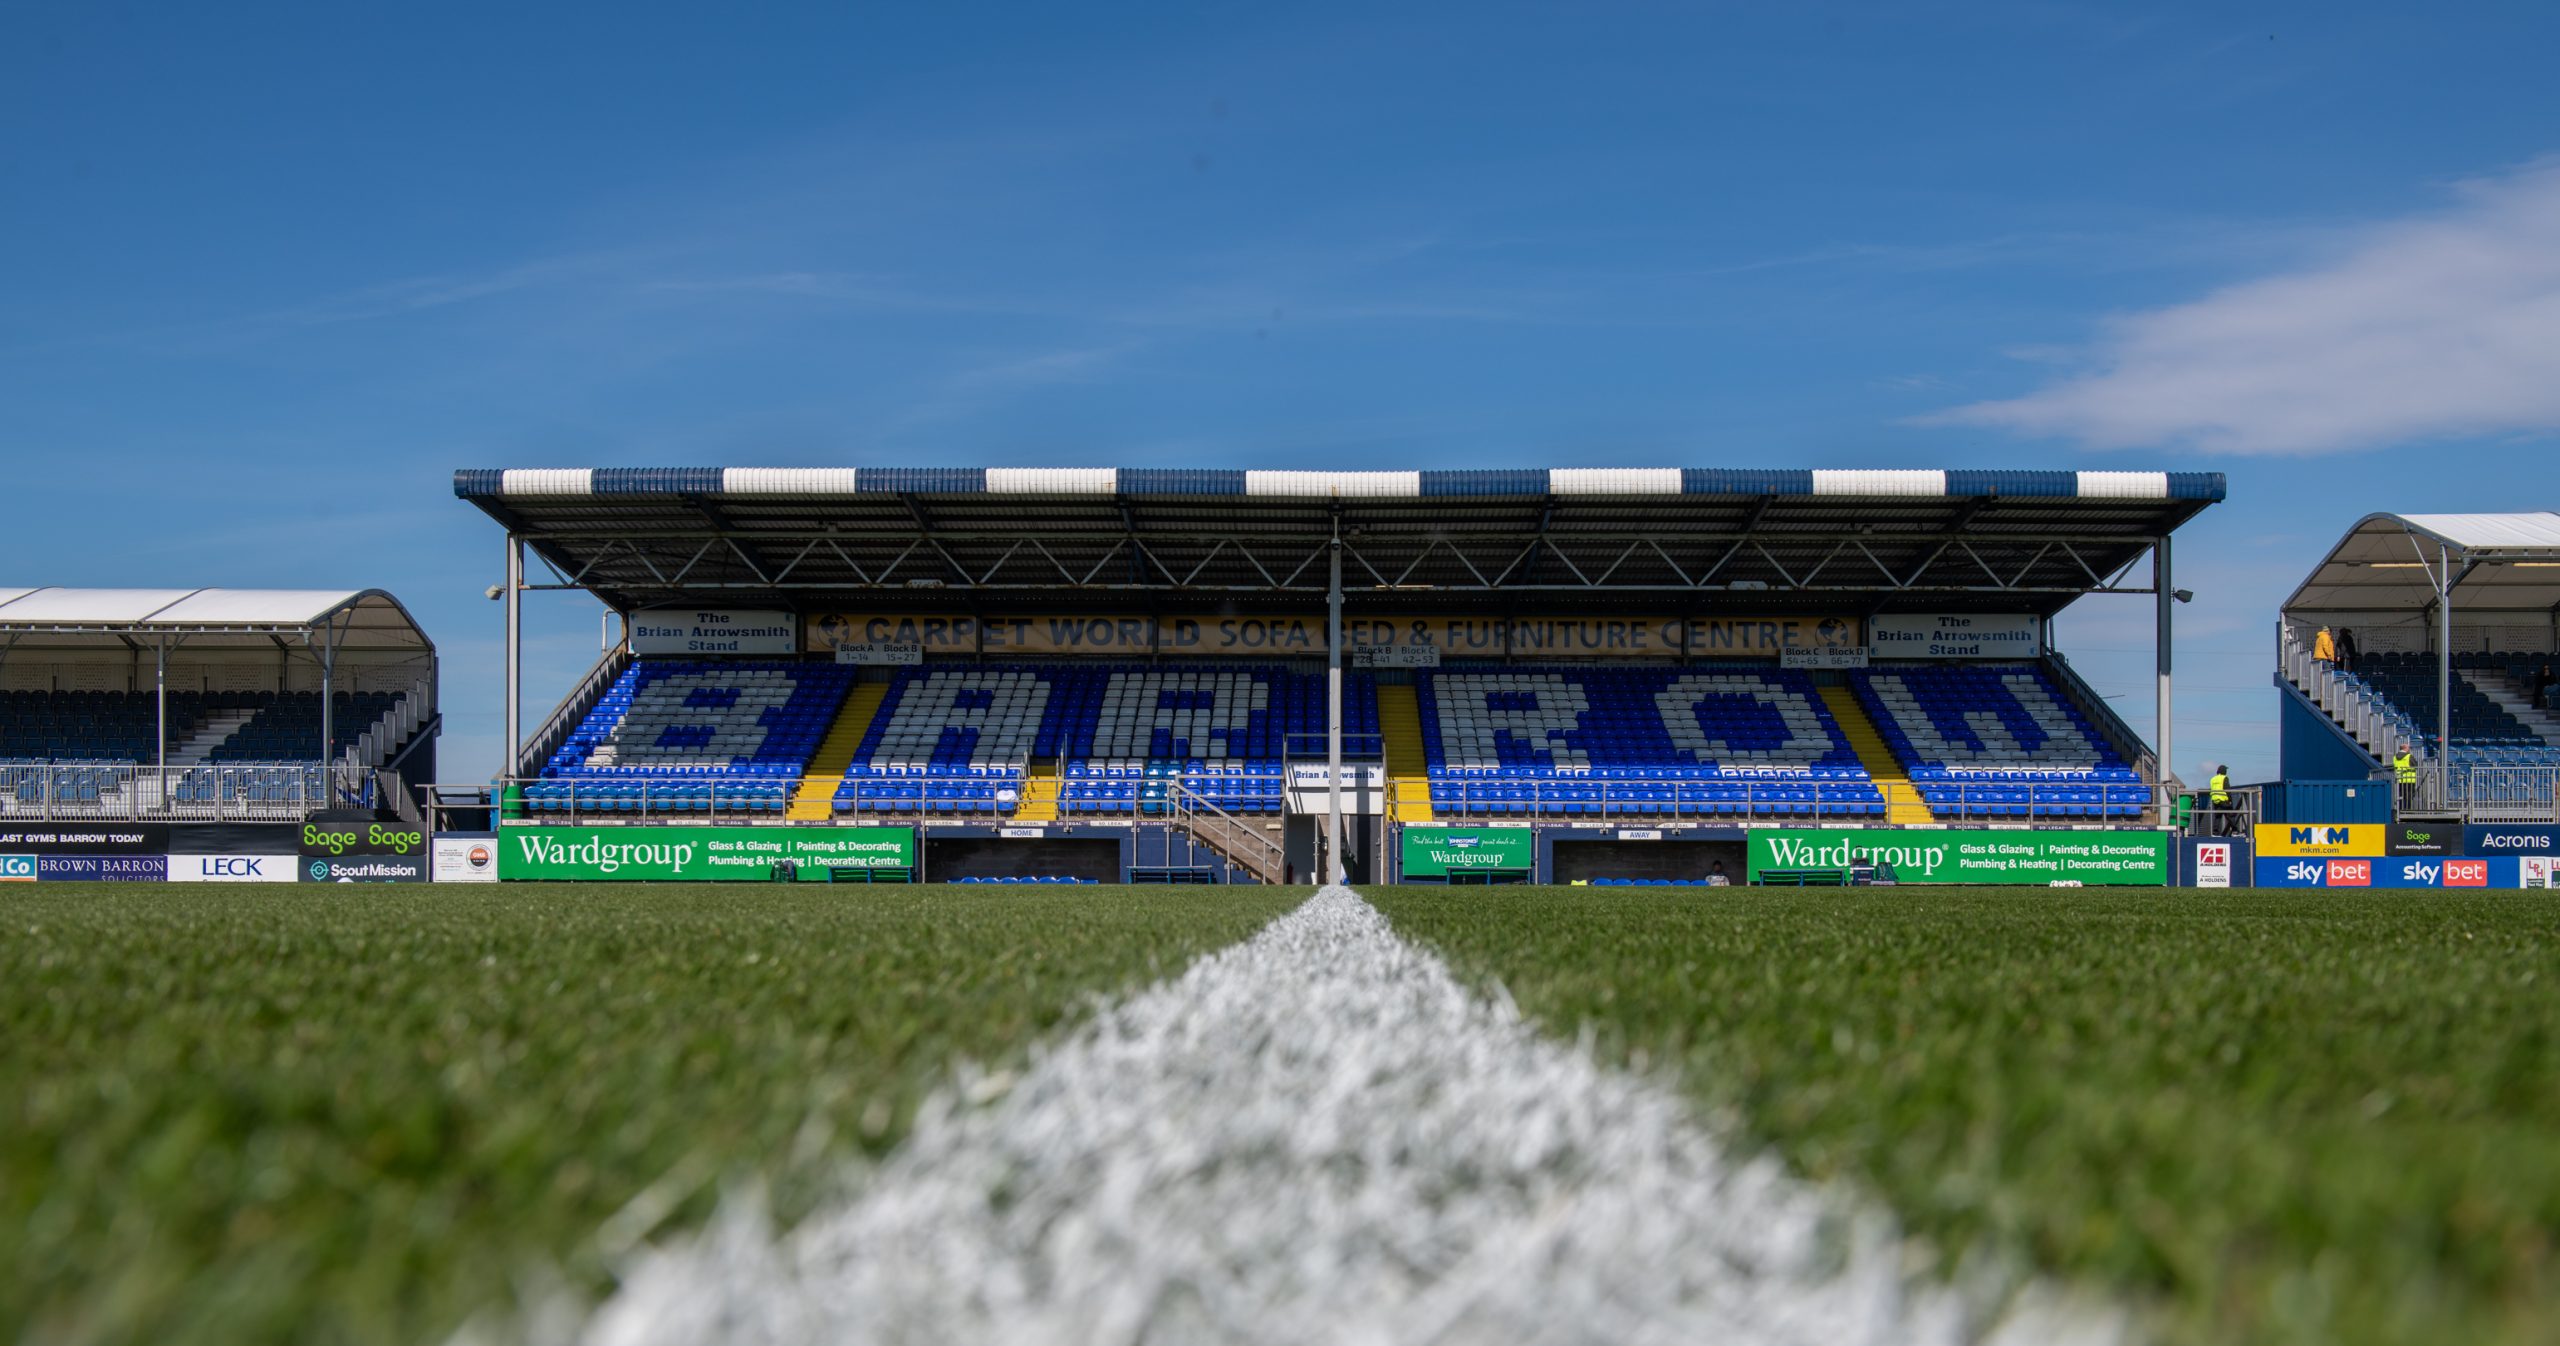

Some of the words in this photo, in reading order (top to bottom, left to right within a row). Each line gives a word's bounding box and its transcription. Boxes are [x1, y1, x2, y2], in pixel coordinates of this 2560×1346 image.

[697, 613, 730, 623] The
[1938, 616, 1971, 627] The
[636, 626, 683, 637] Brian
[691, 626, 790, 637] Arrowsmith
[865, 618, 1034, 647] CARPET
[1049, 618, 1201, 648] WORLD
[1219, 618, 1311, 648] SOFA
[1409, 618, 1433, 646] &
[1447, 620, 1647, 649] FURNITURE
[1660, 619, 1800, 649] CENTRE
[1877, 630, 1924, 641] Brian
[1932, 630, 2031, 641] Arrowsmith
[688, 640, 739, 651] Stand
[840, 644, 866, 652] Block
[867, 644, 874, 652] A
[884, 644, 910, 652] Block
[911, 644, 918, 652] B
[1358, 646, 1384, 654] Block
[1385, 646, 1392, 654] B
[1401, 646, 1427, 654] Block
[1428, 646, 1435, 654] C
[1929, 644, 1980, 655] Stand
[1786, 647, 1812, 656] Block
[1813, 647, 1820, 656] C
[1829, 647, 1855, 656] Block
[1856, 647, 1863, 656] D
[1295, 770, 1319, 778] Brian
[25, 834, 57, 843] GYMS
[60, 834, 106, 843] BARROW
[109, 834, 144, 843] TODAY
[304, 824, 357, 855] Sage
[369, 823, 421, 854] Sage
[2290, 827, 2349, 845] MKM
[2406, 829, 2431, 844] Sage
[2481, 832, 2551, 848] Acronis
[708, 841, 734, 851] Glass
[735, 841, 745, 851] &
[746, 841, 782, 853] Glazing
[796, 841, 837, 853] Painting
[837, 841, 847, 851] &
[848, 841, 902, 853] Decorating
[1960, 844, 1986, 854] Glass
[1987, 844, 1997, 854] &
[1998, 844, 2035, 856] Glazing
[2049, 845, 2089, 856] Painting
[2091, 845, 2100, 855] &
[2102, 845, 2155, 857] Decorating
[2299, 846, 2340, 855] mkm.com
[40, 859, 97, 872] BROWN
[102, 859, 165, 872] BARRON
[202, 858, 262, 876] LECK
[708, 856, 755, 867] Plumbing
[756, 856, 766, 866] &
[814, 856, 867, 867] Decorating
[868, 856, 901, 866] Centre
[1960, 859, 2007, 871] Plumbing
[2008, 859, 2018, 869] &
[2019, 859, 2058, 872] Heating
[2067, 859, 2121, 871] Decorating
[2122, 860, 2155, 870] Centre
[2287, 861, 2324, 885] sky
[2330, 862, 2366, 880] bet
[2403, 861, 2440, 885] sky
[2447, 862, 2483, 880] bet
